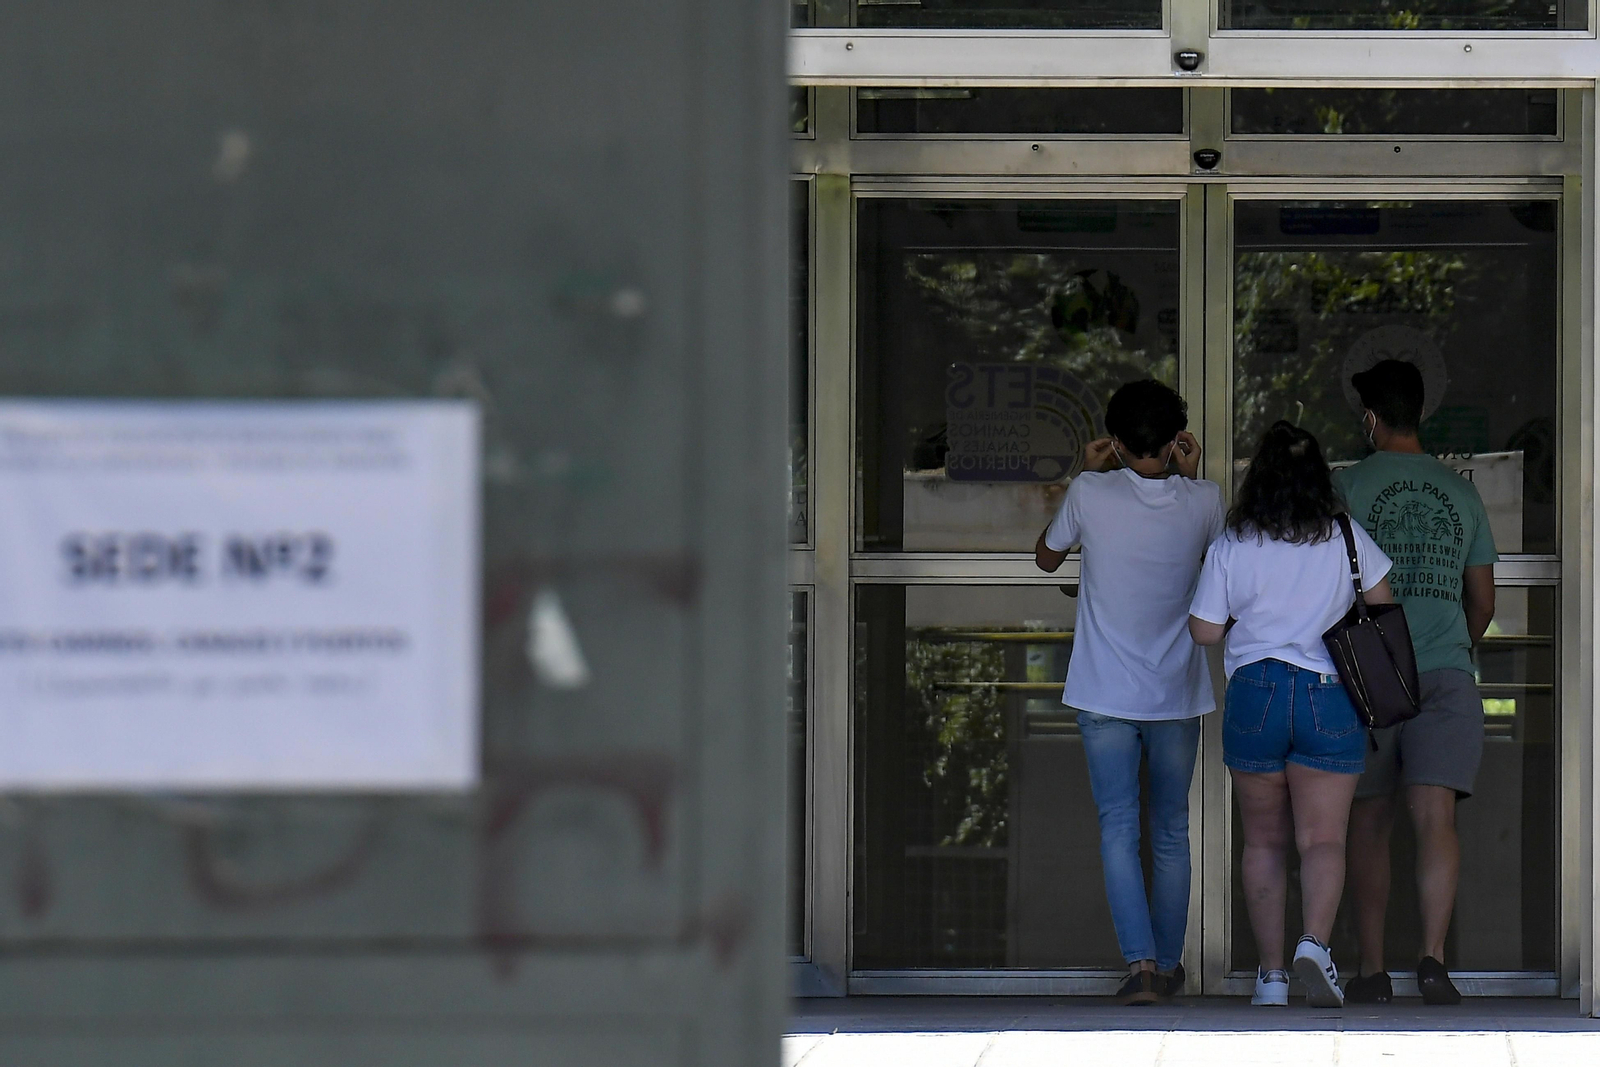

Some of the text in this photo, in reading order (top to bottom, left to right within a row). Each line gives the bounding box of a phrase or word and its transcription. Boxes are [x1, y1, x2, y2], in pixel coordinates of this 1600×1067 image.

[1422, 481, 1464, 548] PARADISE
[62, 530, 203, 588] SEDE
[1390, 572, 1434, 585] 241108
